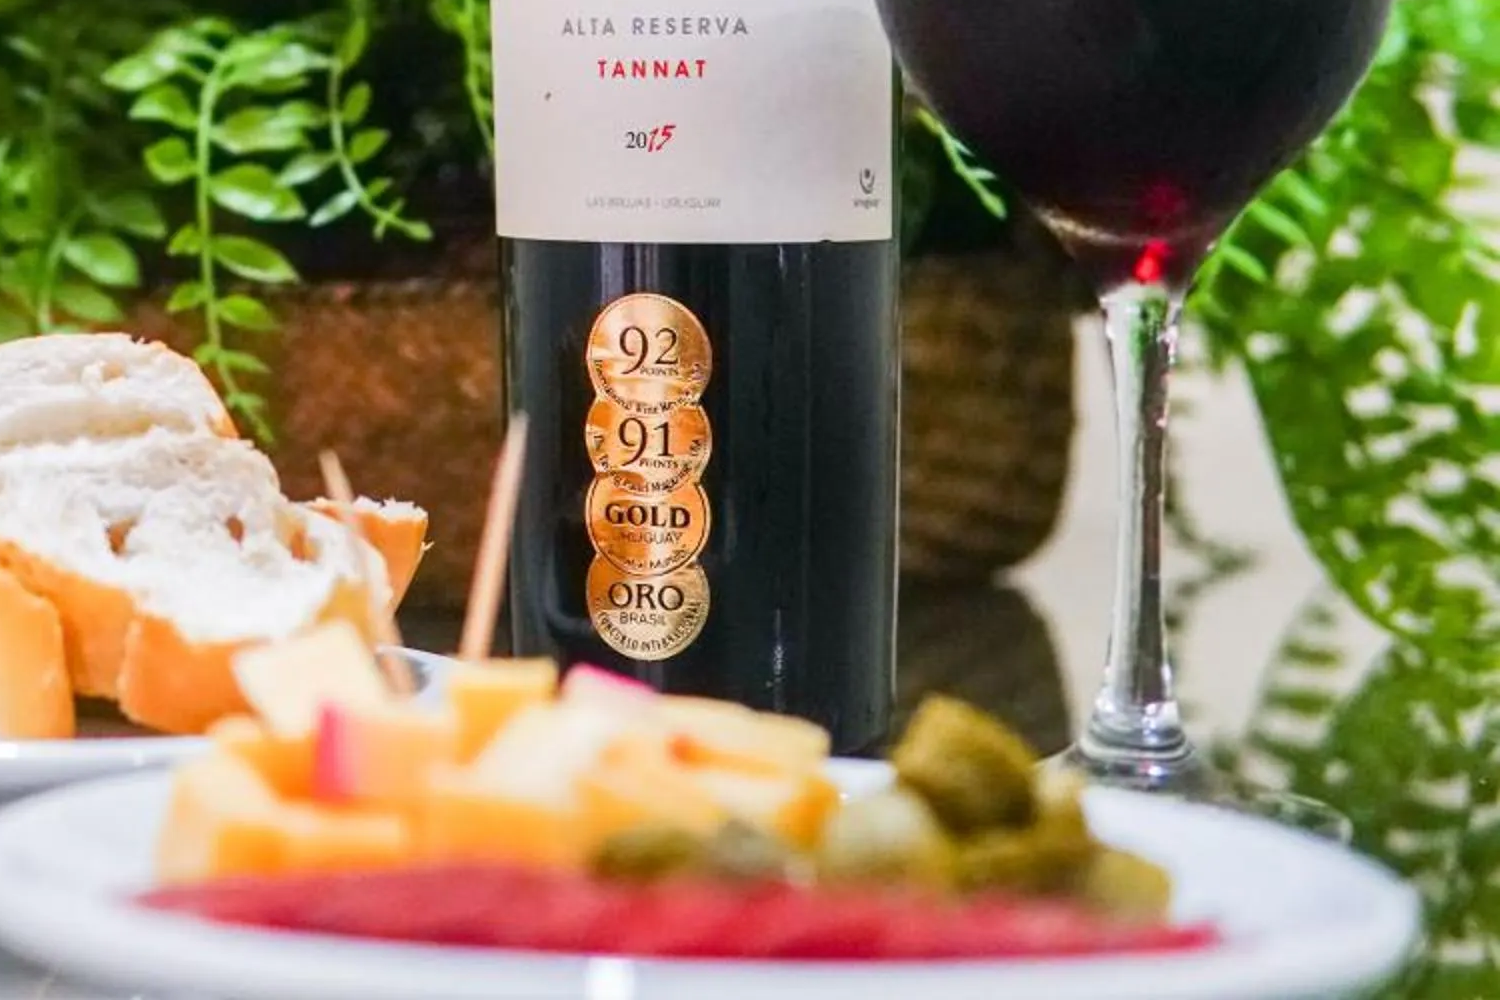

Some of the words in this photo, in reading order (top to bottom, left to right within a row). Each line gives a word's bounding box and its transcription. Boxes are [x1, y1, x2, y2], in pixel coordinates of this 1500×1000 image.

[562, 17, 616, 36] ALTA
[632, 16, 749, 36] RESERVA
[597, 59, 707, 79] TANNAT
[625, 124, 677, 153] 2015
[619, 325, 679, 375] 92
[618, 417, 674, 466] 91
[605, 503, 691, 528] GOLD
[608, 582, 684, 611] ORO
[619, 611, 667, 626] BRASIL
